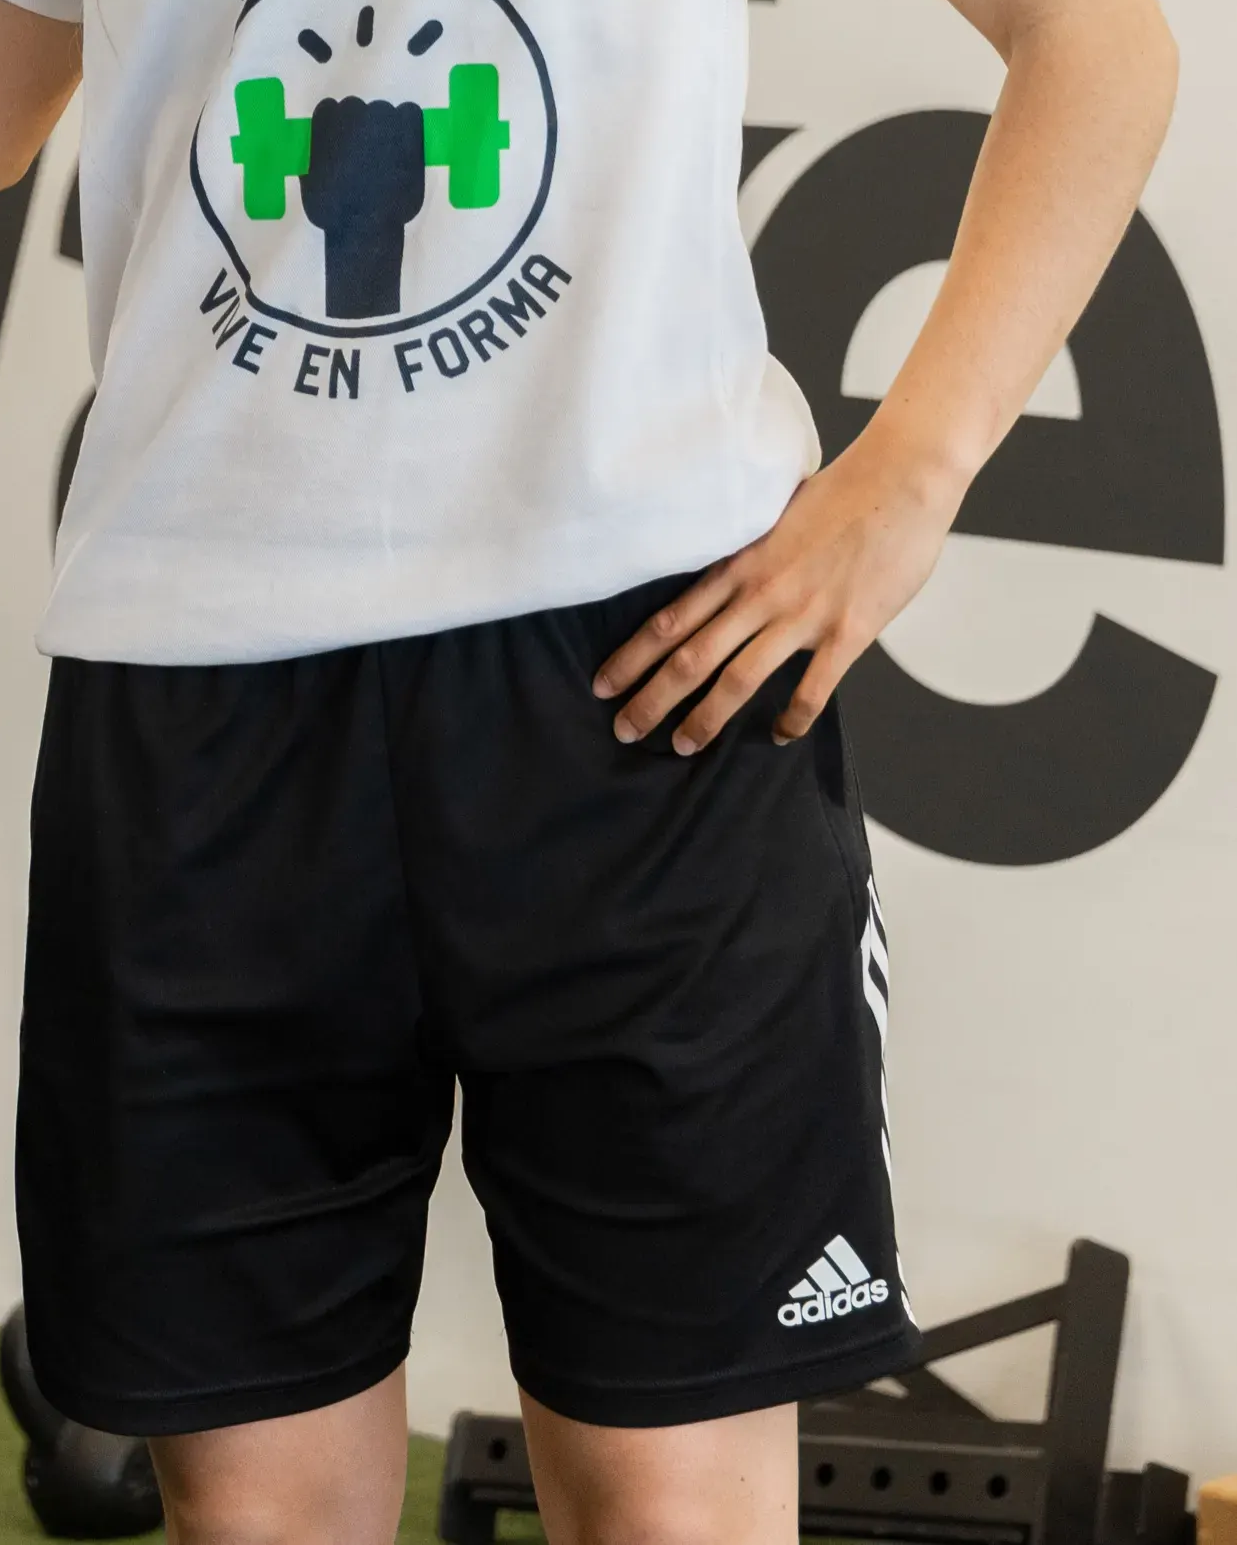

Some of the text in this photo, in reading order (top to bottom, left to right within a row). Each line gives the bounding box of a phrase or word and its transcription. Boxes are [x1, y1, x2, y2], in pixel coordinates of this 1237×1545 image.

[198, 254, 574, 400] VIVE EN FORMA
[777, 1278, 889, 1327] adidas
